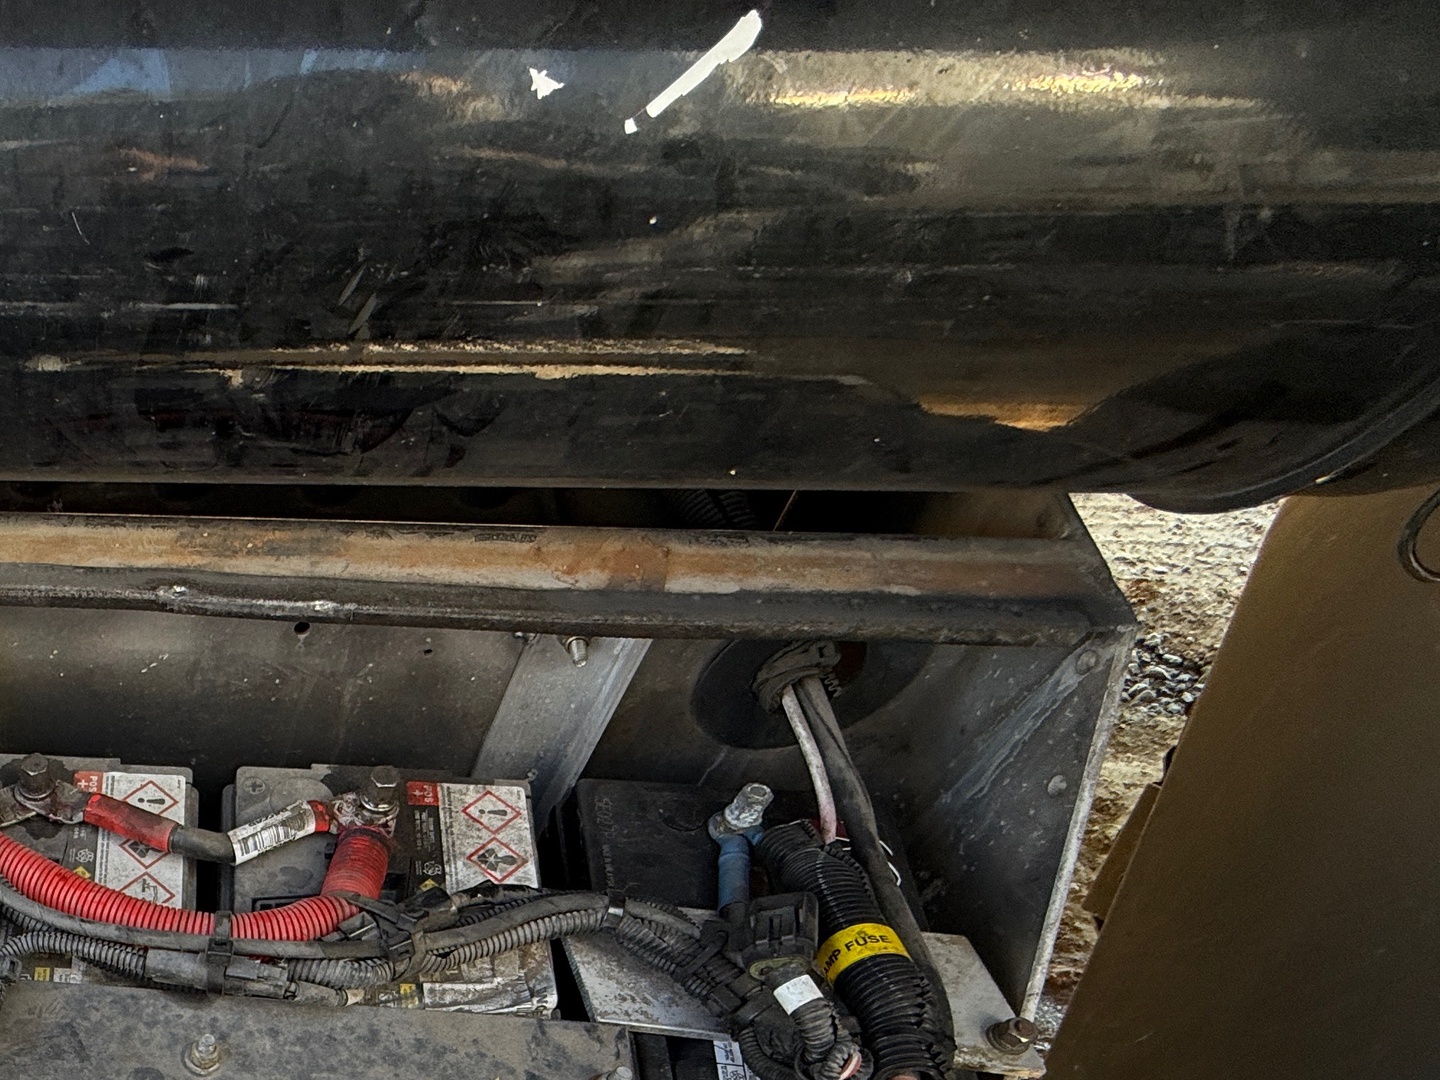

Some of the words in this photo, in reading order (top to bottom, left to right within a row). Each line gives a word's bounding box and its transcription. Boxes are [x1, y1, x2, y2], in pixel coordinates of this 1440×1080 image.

[88, 775, 97, 792] POS
[423, 783, 432, 802] POS
[845, 934, 890, 952] FUSE
